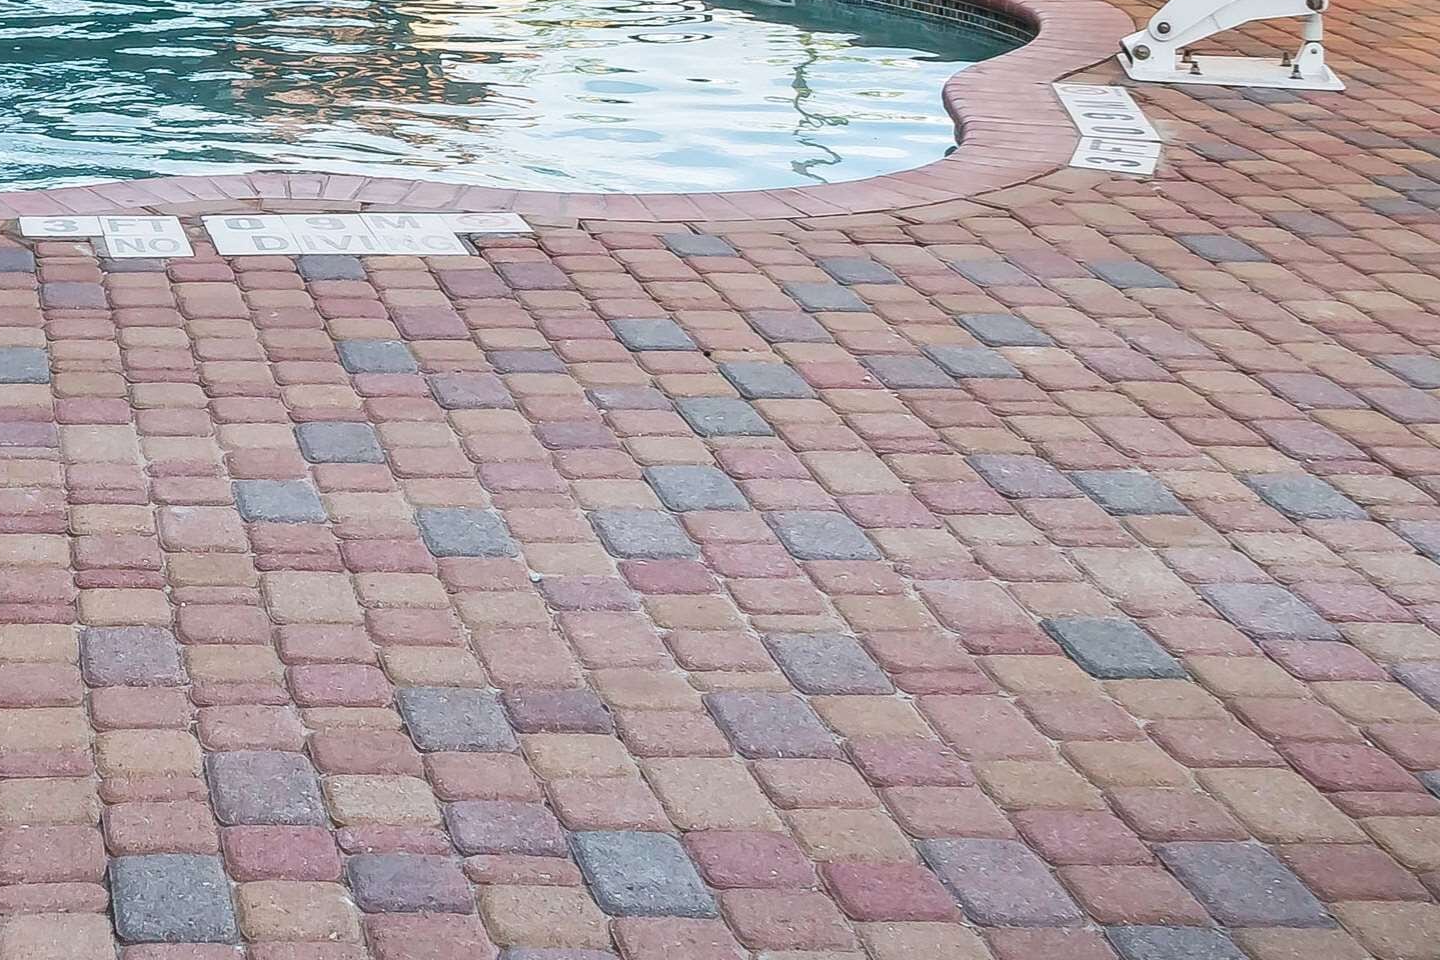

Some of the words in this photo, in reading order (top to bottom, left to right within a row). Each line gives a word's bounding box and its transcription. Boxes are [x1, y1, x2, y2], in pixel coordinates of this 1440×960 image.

[42, 219, 79, 233] 3
[106, 218, 172, 233] FT
[305, 216, 347, 231] 9
[371, 216, 421, 229] M
[113, 238, 181, 253] NO
[252, 235, 457, 251] DIVING
